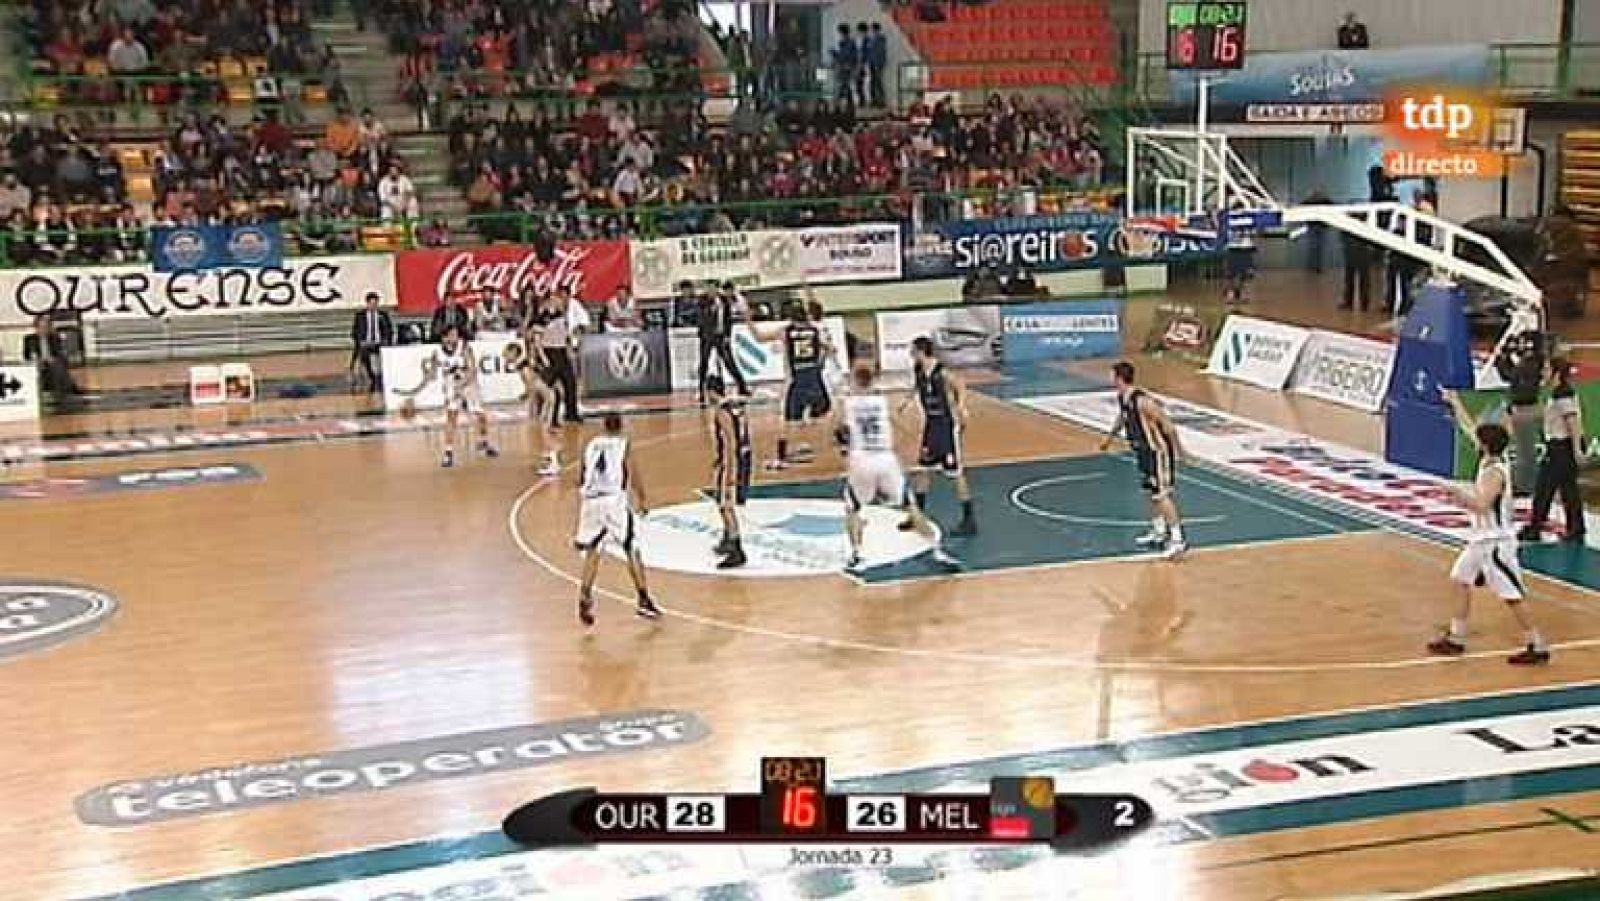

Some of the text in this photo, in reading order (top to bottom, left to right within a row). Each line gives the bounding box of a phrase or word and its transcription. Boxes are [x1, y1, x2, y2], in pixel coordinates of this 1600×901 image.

[1214, 27, 1238, 61] 16
[15, 265, 341, 317] OURENSE
[111, 722, 686, 820] teleoperator
